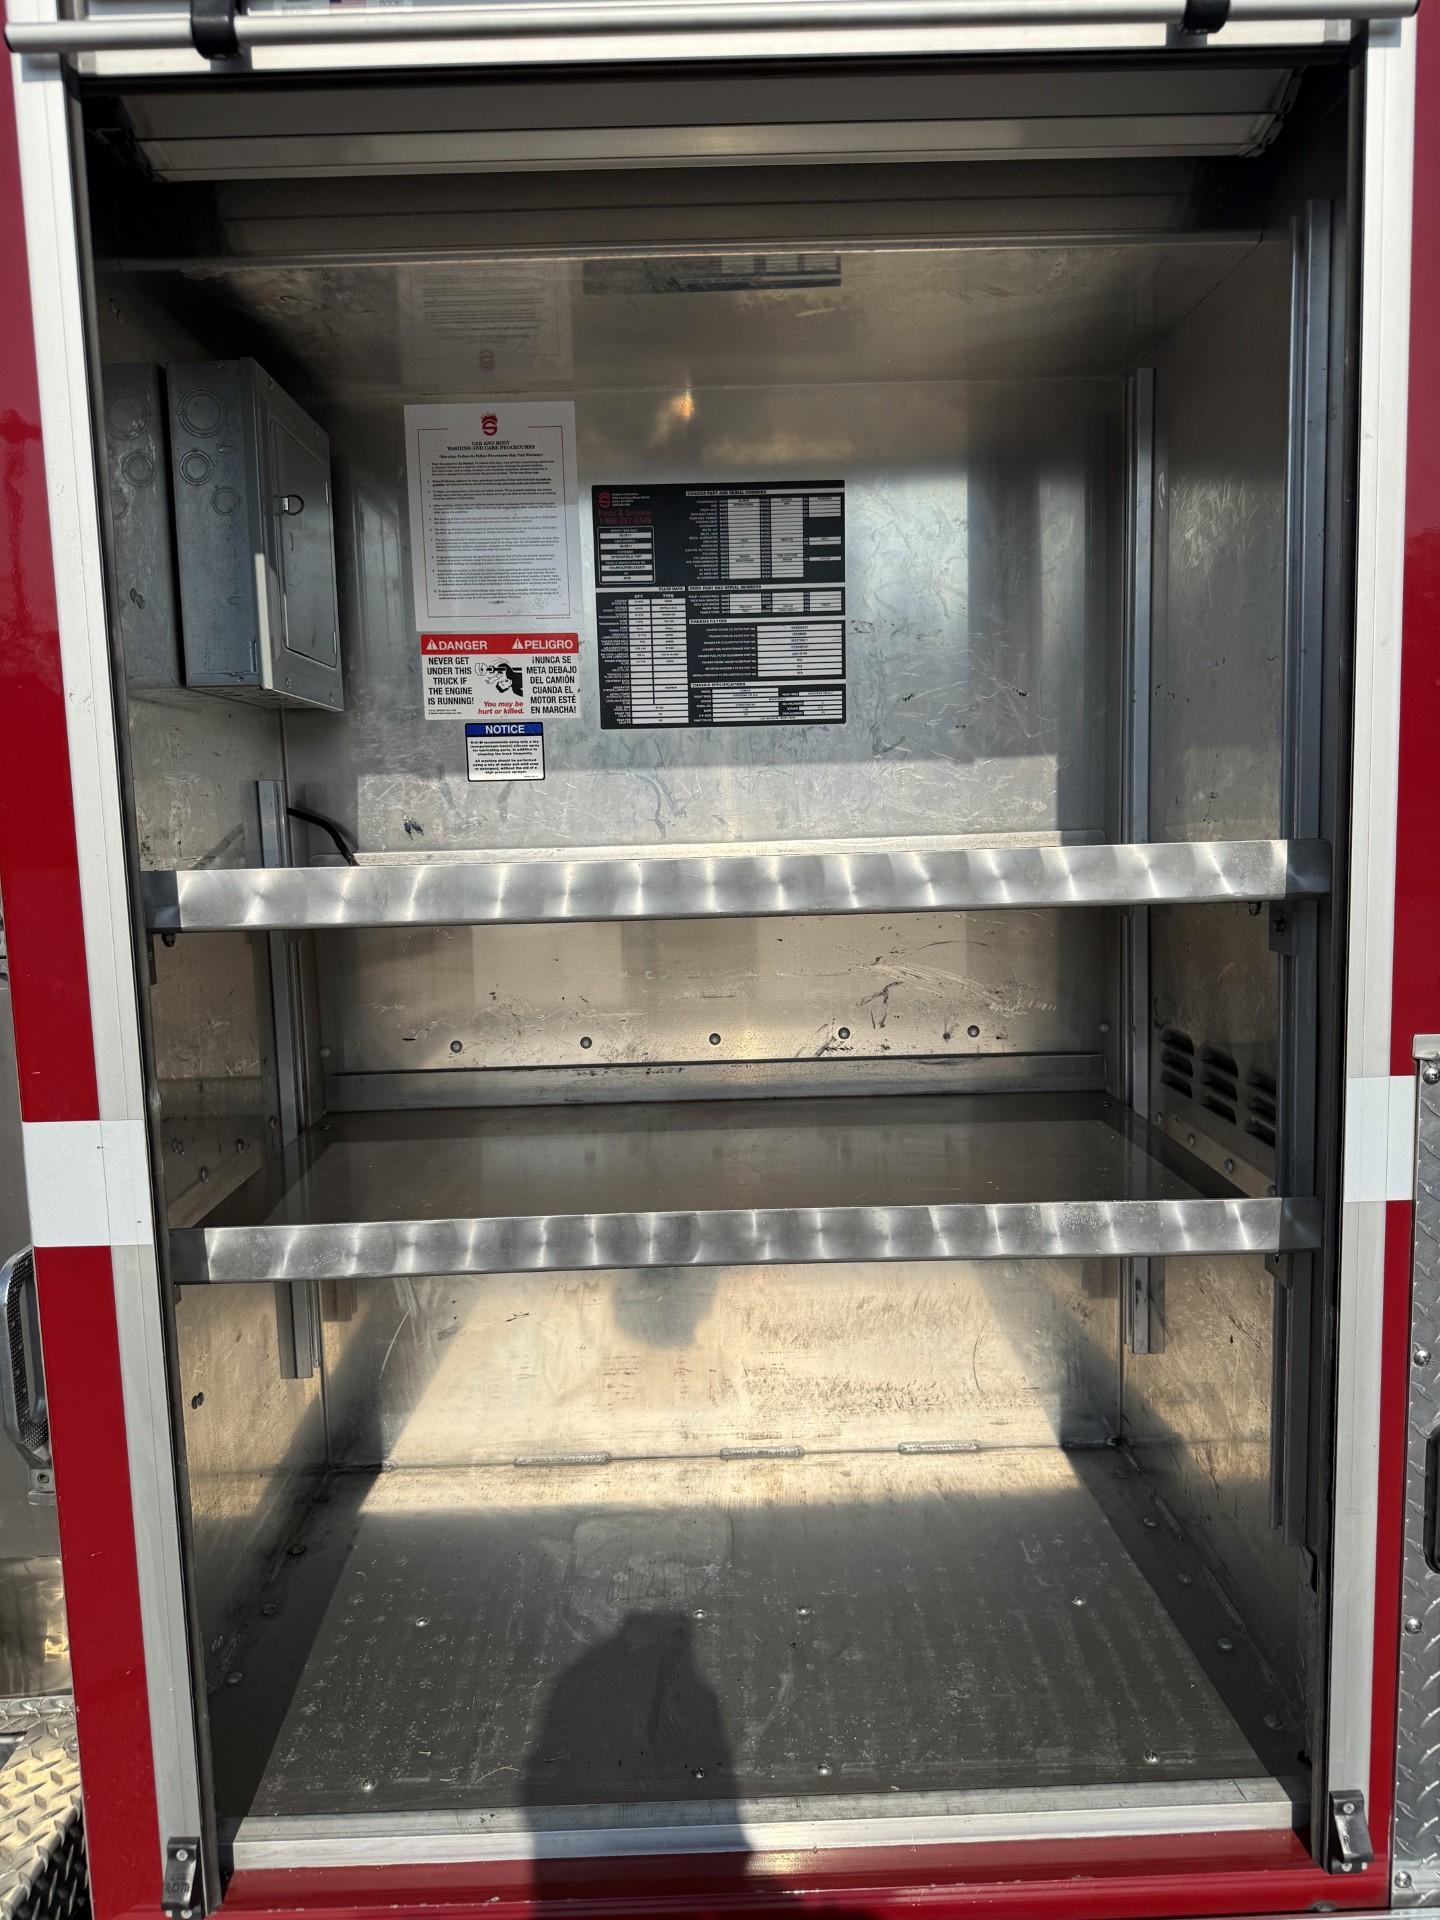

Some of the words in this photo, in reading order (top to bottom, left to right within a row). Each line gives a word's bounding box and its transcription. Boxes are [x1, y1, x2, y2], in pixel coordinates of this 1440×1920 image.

[439, 640, 488, 651] DANGER
[524, 639, 574, 650] PELIGRO
[428, 656, 453, 665] NEVER
[455, 656, 470, 665] GET
[532, 656, 560, 664] ¡NUNCA
[562, 655, 572, 664] SE
[427, 667, 453, 675] UNDER
[454, 667, 472, 675] THIS
[526, 666, 547, 674] META
[549, 665, 577, 674] DEBAJO
[433, 677, 459, 685] TRUCK
[460, 677, 467, 685] IF
[530, 676, 544, 684] DEL
[546, 674, 575, 684] CAMIÓN
[428, 687, 443, 695] THE
[445, 687, 473, 695] ENGINE
[532, 686, 563, 694] CUANDA
[565, 686, 574, 694] EL
[428, 697, 436, 705] IS
[437, 697, 474, 705] RUNNING!
[530, 696, 557, 704] MOTOR
[558, 694, 577, 704] ESTÉ
[531, 706, 541, 714] EN
[542, 705, 577, 714] MARCHA!
[485, 725, 526, 734] NOTICE
